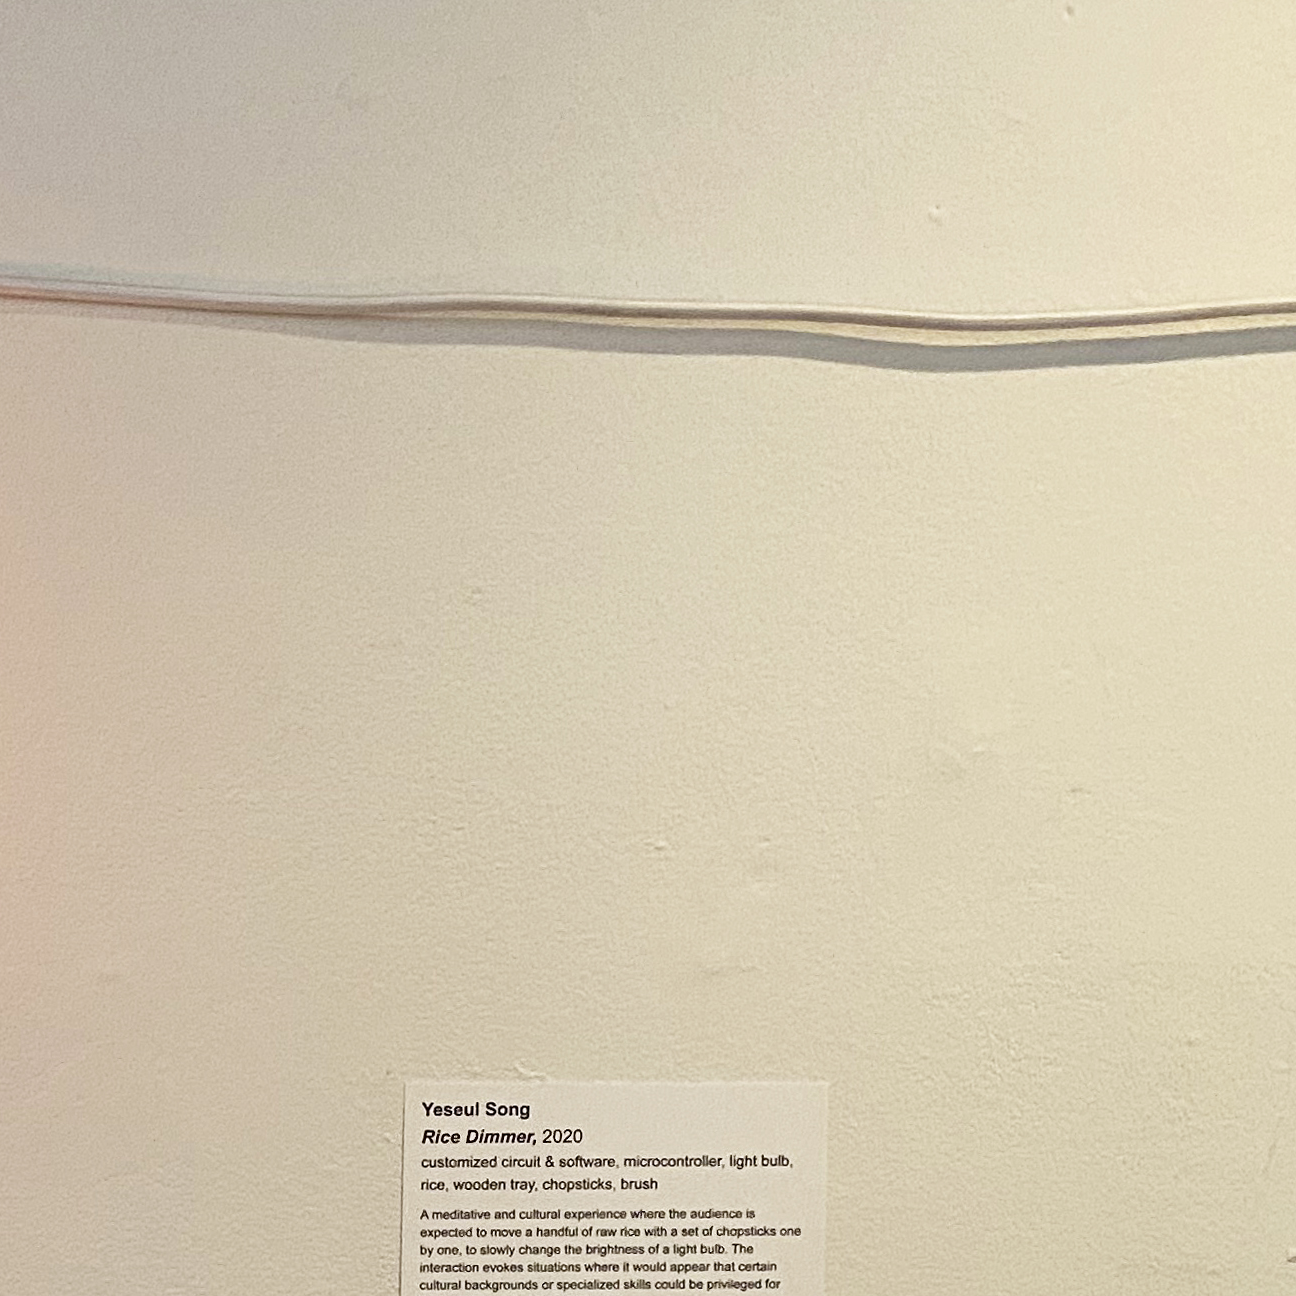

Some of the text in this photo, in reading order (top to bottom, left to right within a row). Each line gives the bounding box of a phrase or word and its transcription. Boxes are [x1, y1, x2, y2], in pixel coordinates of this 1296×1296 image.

[421, 1101, 531, 1121] Yeseul Song
[421, 1128, 584, 1147] Rice Dimmer, 2020
[420, 1154, 793, 1171] customized circuit & software, microcontroller, light bulb,
[420, 1177, 659, 1194] rice, wooden tray, chopsticks, brush
[419, 1207, 756, 1223] A meditative and cultural experience where the audience is
[419, 1224, 802, 1241] expected to move a handful of raw rice with a set of chopsticks one
[419, 1242, 755, 1259] by one, to slowly change the brightness of a light bulb. The
[419, 1260, 778, 1275] interaction evokes situations where it would appear that certain
[418, 1277, 782, 1294] cultural backgrounds or specialized skills could be privileged for
